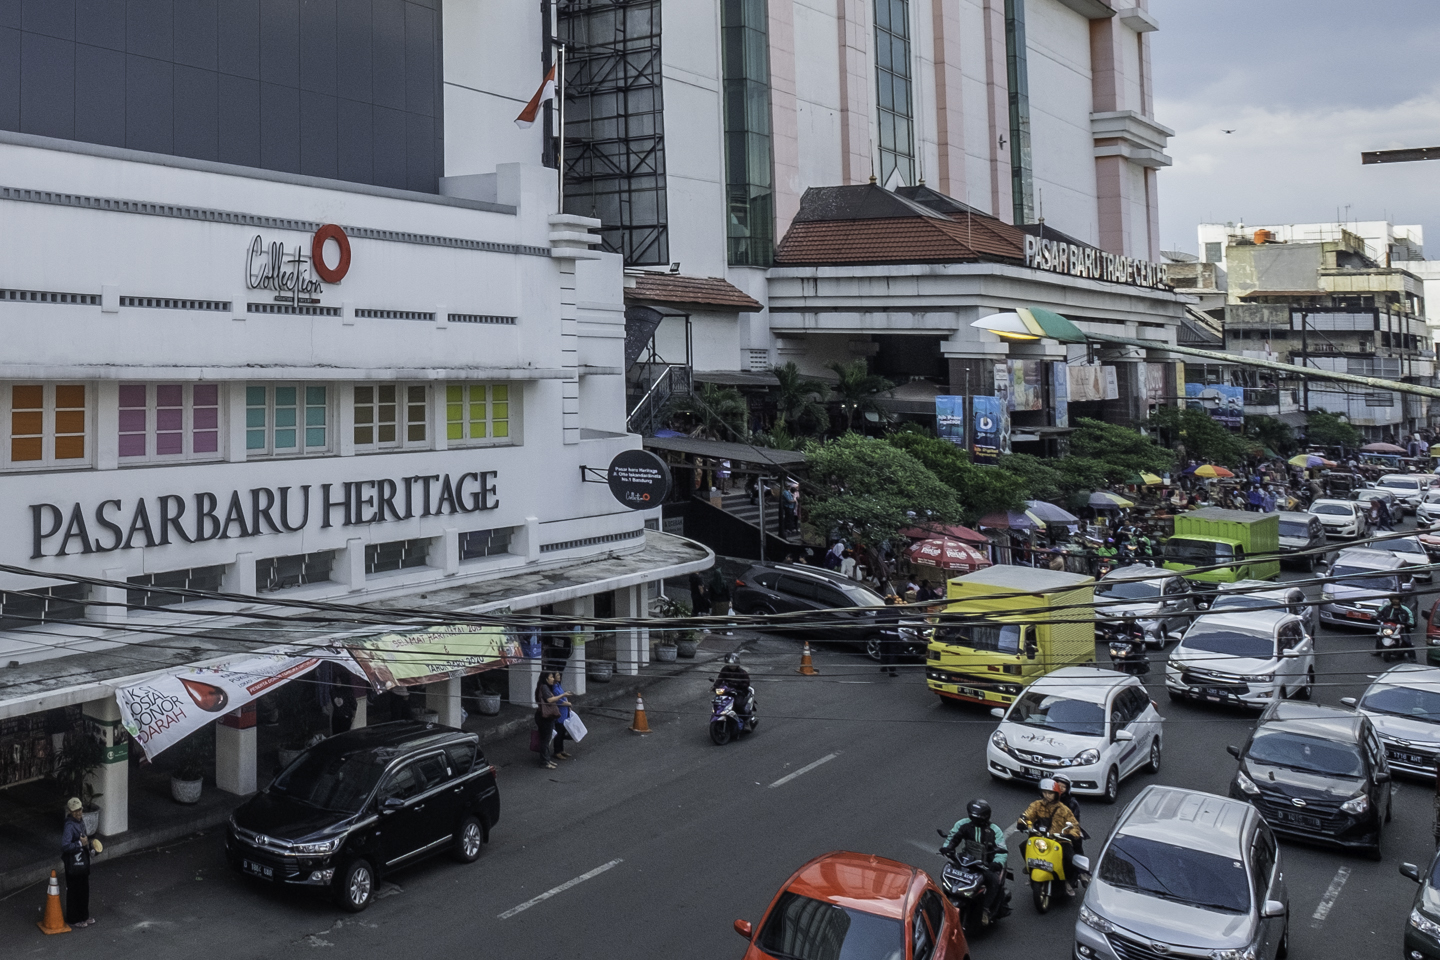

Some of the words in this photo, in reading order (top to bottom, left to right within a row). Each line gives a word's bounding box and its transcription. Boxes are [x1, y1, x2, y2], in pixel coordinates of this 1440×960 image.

[247, 234, 323, 307] Collection
[1024, 234, 1068, 274] PASAR
[1069, 244, 1101, 279] BARU
[1101, 252, 1134, 283] TRADE
[29, 484, 311, 559] PASARBARU
[321, 470, 500, 528] HERITAGE
[138, 707, 187, 744] DARAH
